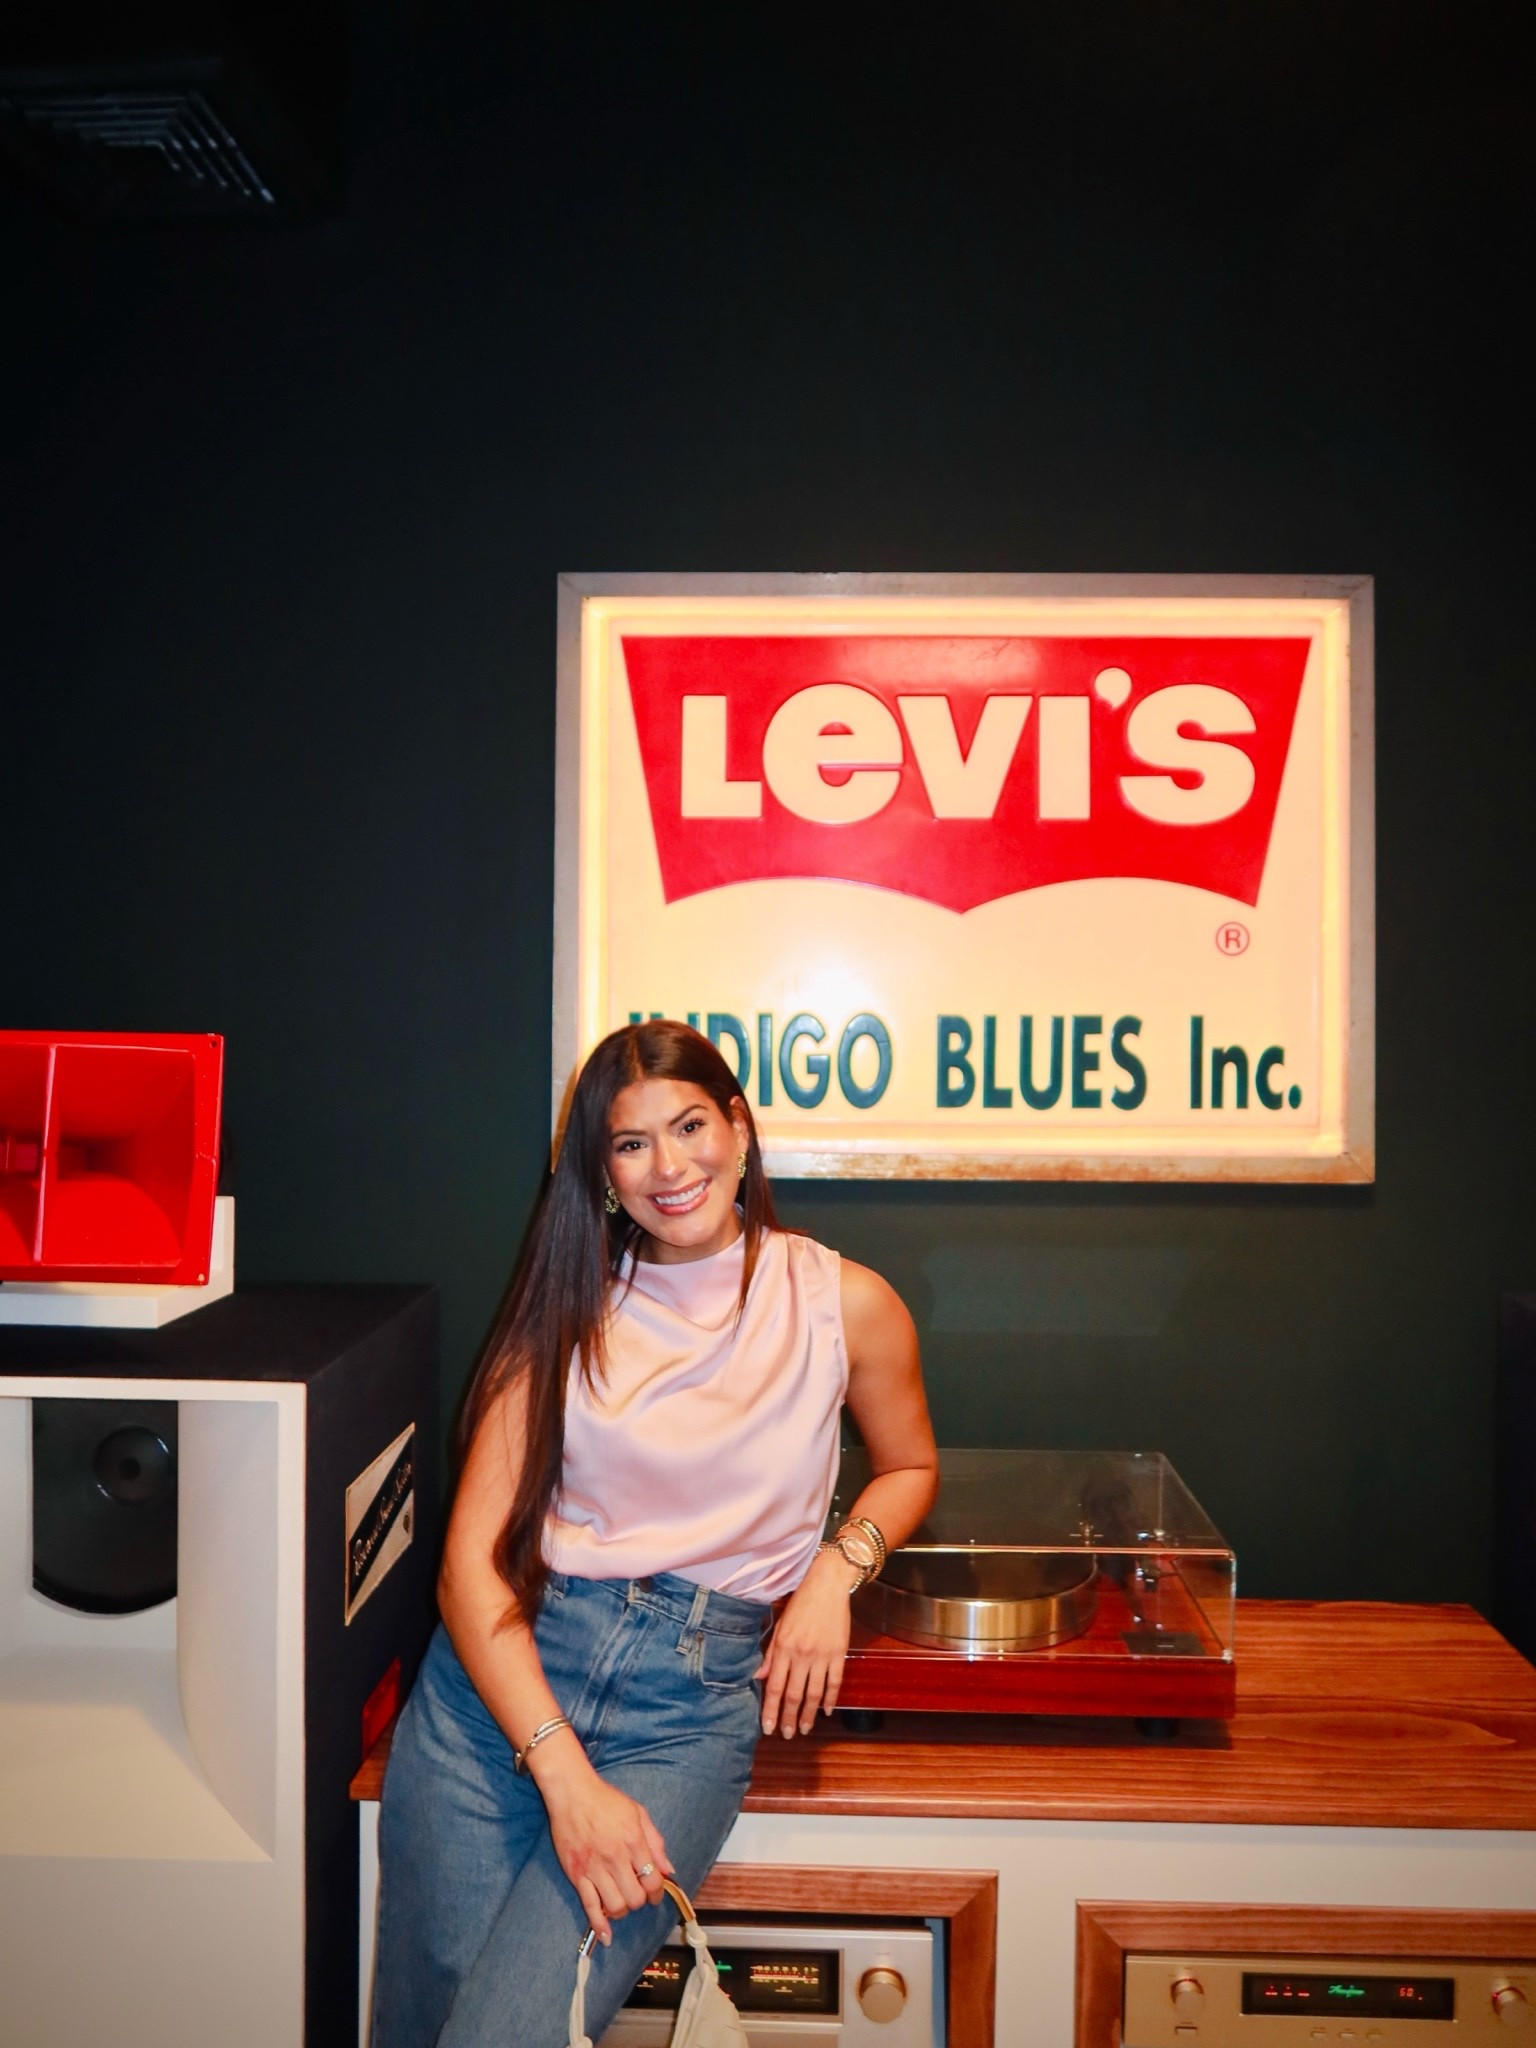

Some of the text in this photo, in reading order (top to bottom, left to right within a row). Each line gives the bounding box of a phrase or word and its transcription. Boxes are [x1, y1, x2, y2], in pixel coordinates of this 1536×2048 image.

[629, 1012, 1303, 1112] DIGO BLUES Inc.
